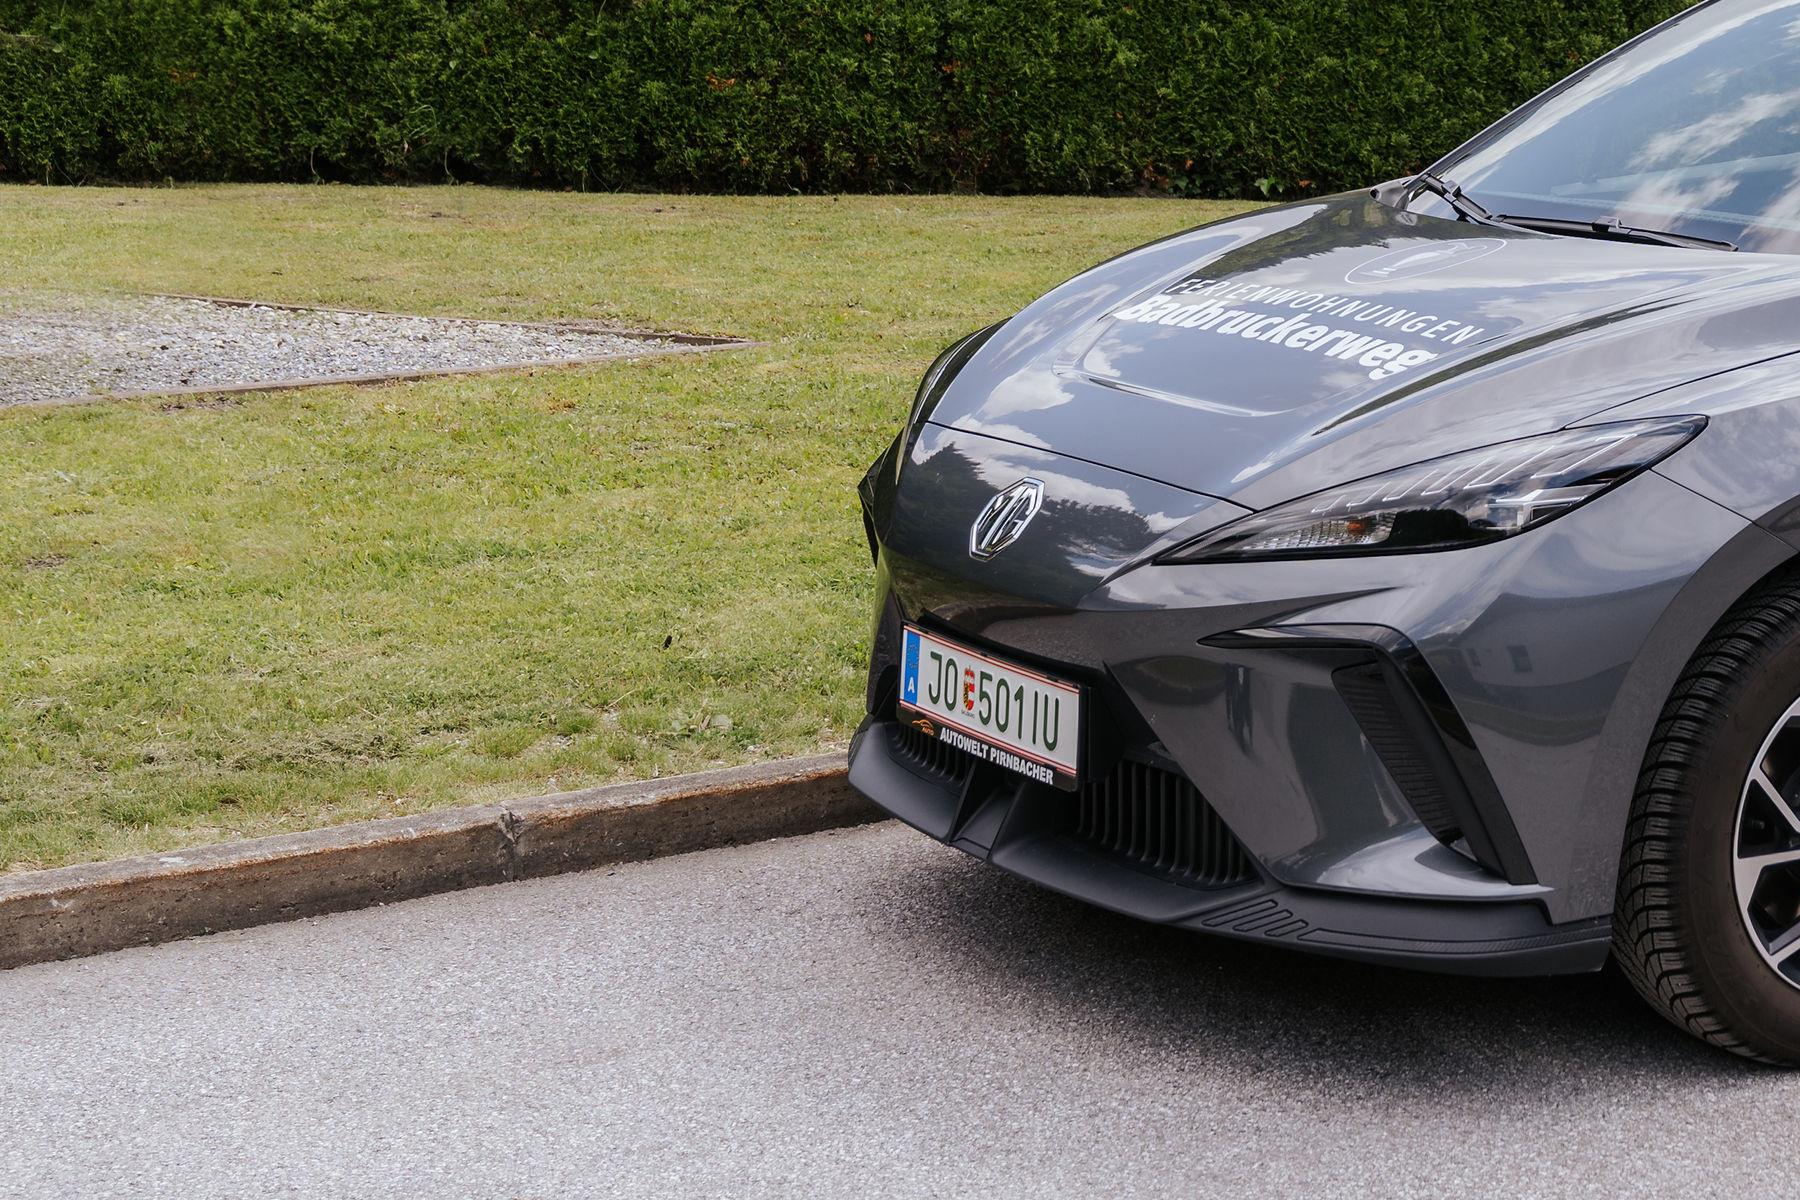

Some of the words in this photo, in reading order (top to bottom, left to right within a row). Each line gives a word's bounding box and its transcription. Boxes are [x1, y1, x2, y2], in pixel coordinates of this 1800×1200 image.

[1113, 296, 1438, 379] Badbruckerweg
[1167, 278, 1485, 346] FERIENWOHNUNGEN
[907, 676, 915, 694] A
[928, 651, 959, 711] JO
[940, 727, 989, 761] AUTOWELT
[990, 747, 1054, 785] PIRNBACHER
